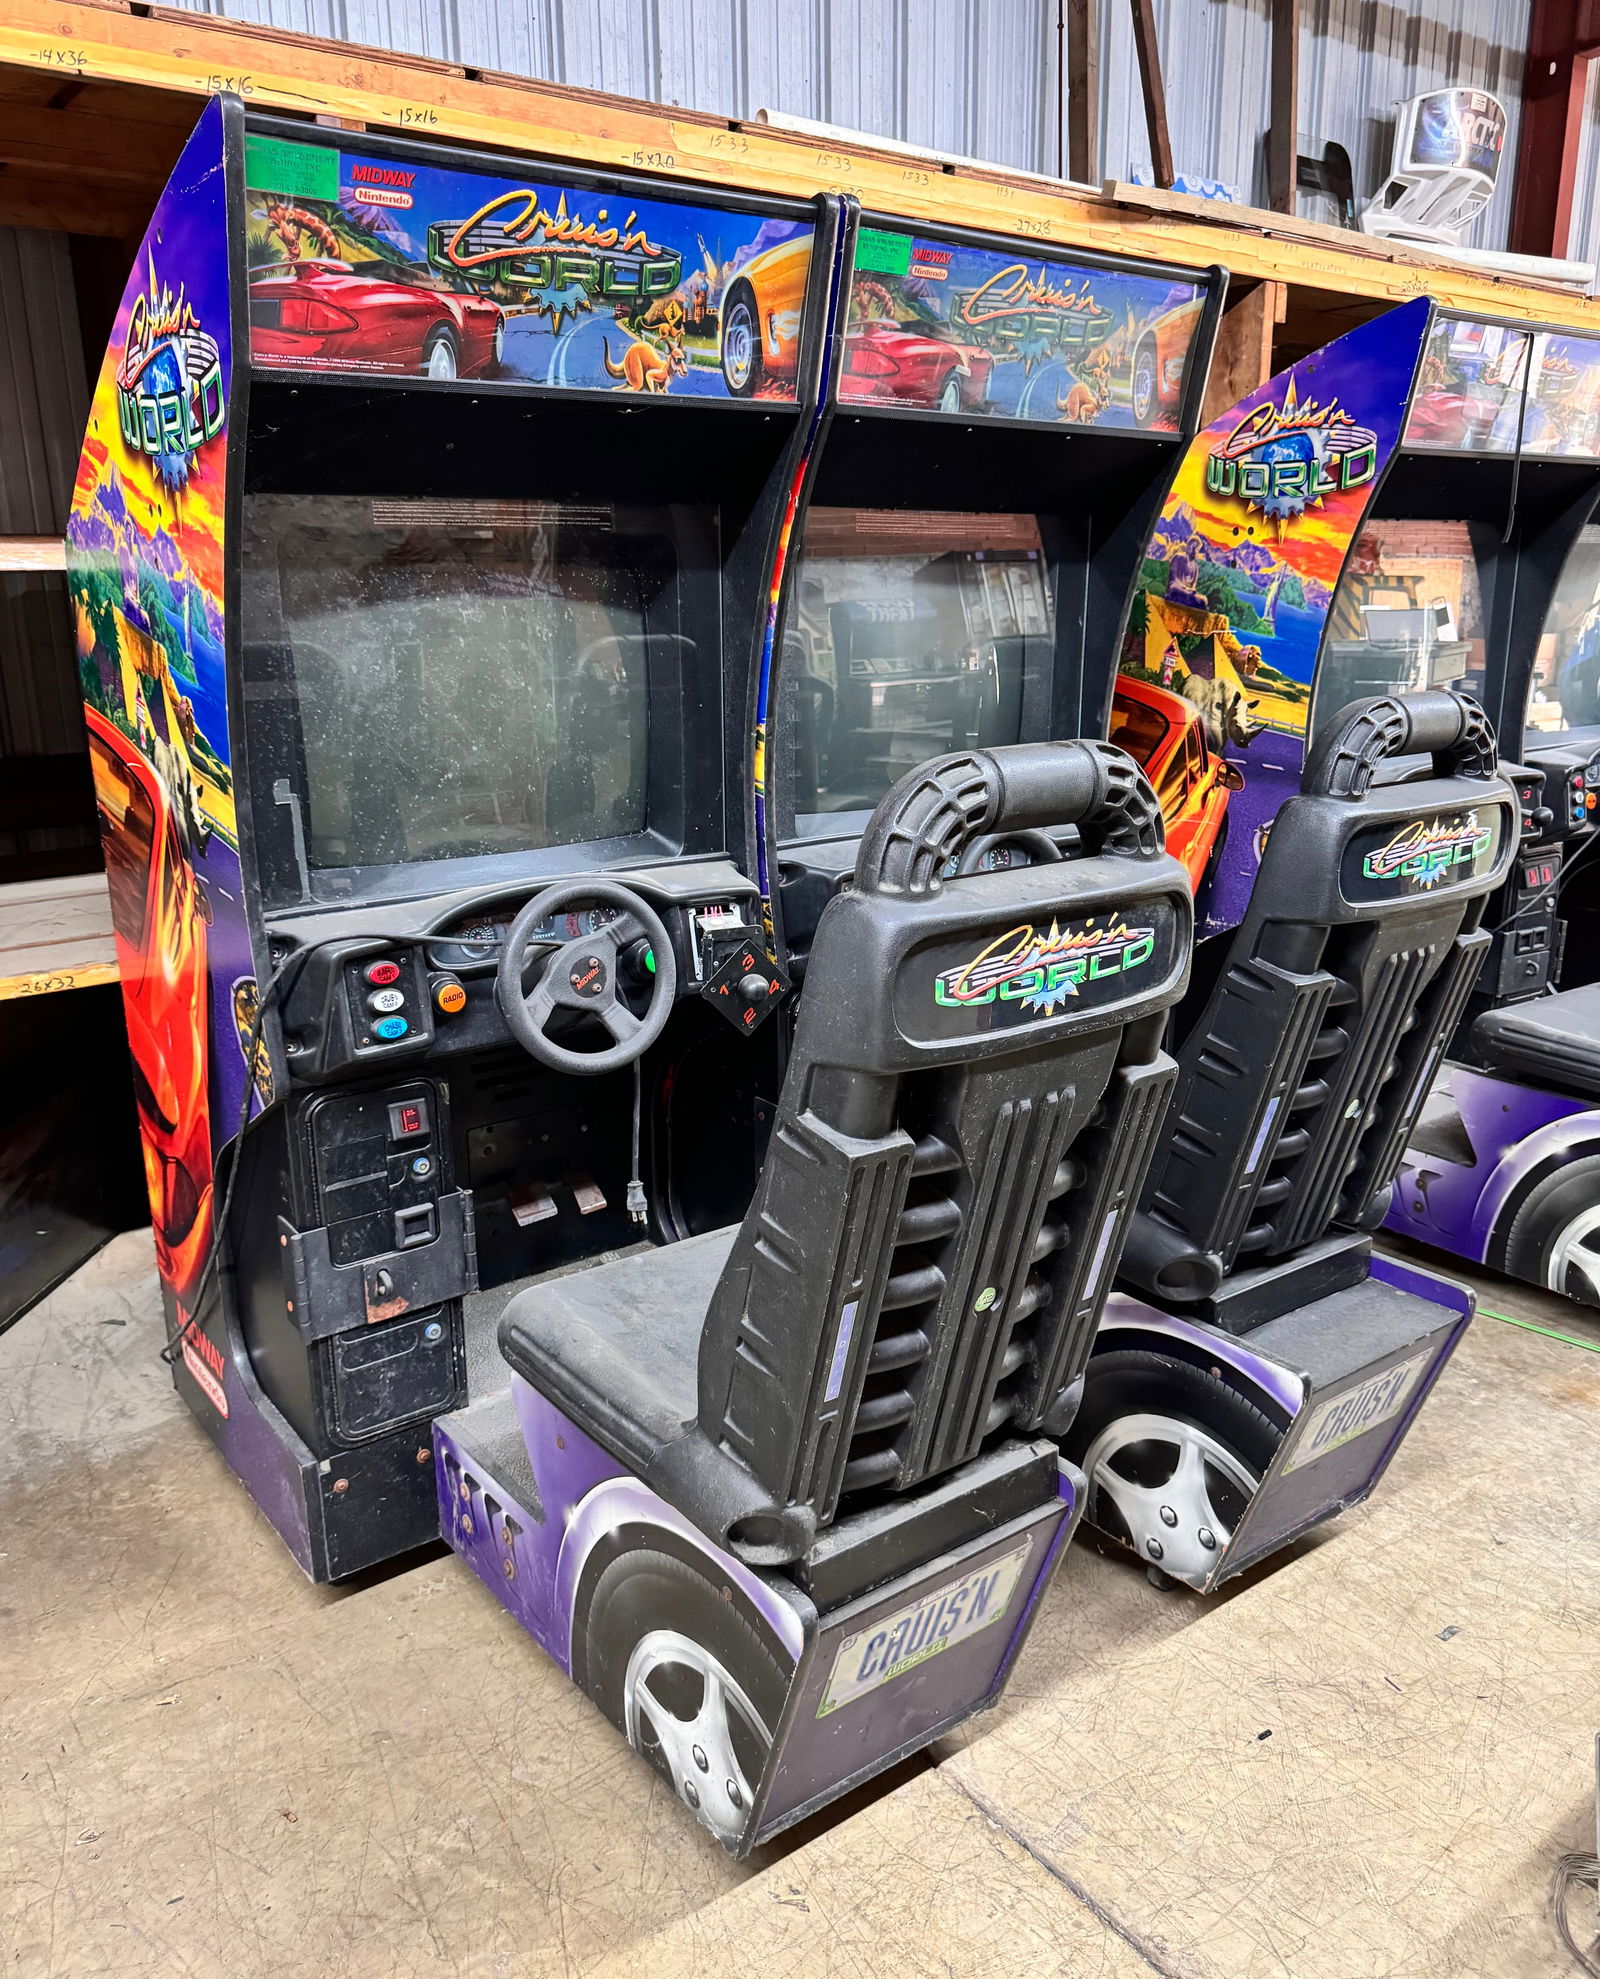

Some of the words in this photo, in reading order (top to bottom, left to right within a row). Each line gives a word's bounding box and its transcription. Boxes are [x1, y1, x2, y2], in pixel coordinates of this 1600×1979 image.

[816, 153, 852, 173] 1533
[351, 164, 417, 189] MIDWAY
[901, 170, 930, 186] 1533
[358, 190, 410, 206] Nintendo
[448, 189, 662, 268] Cruis'n
[427, 226, 682, 297] WORLD
[912, 247, 954, 265] MIDWAY
[913, 266, 947, 278] Nintendo
[962, 264, 1101, 325] Cruis'n
[117, 360, 226, 456] WORLD
[1206, 443, 1377, 500] WORLD
[1362, 833, 1491, 879] WORLD
[741, 954, 756, 972] 3
[935, 935, 1154, 1007] WORLD
[575, 966, 600, 991] MIDWAY
[768, 979, 780, 995] 4
[442, 991, 464, 1005] RADIO
[719, 984, 730, 997] 1
[743, 1007, 757, 1024] 2
